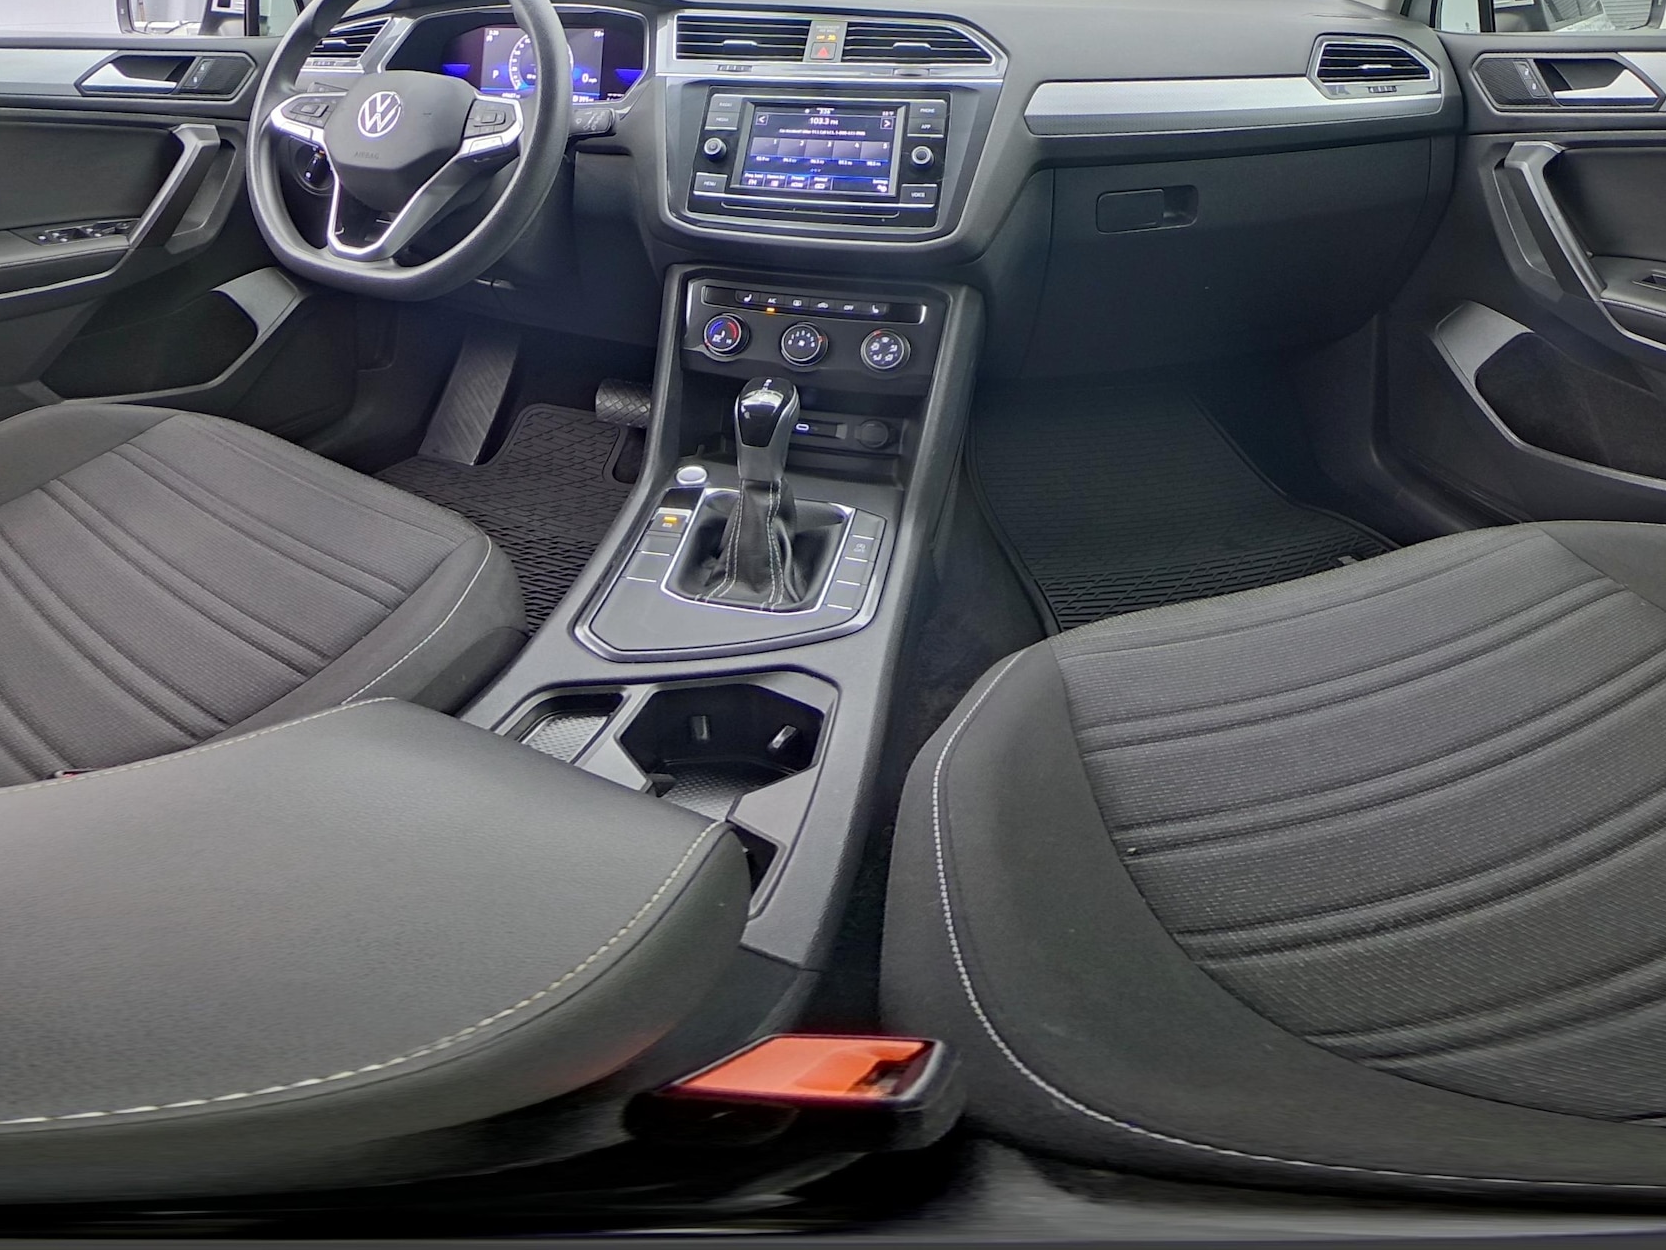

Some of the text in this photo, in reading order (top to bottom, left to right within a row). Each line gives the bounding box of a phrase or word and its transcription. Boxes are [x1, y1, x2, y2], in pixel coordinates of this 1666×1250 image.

[492, 69, 499, 79] P
[581, 73, 589, 83] 0
[810, 117, 830, 126] 103.3
[354, 151, 380, 160] AIRBAG
